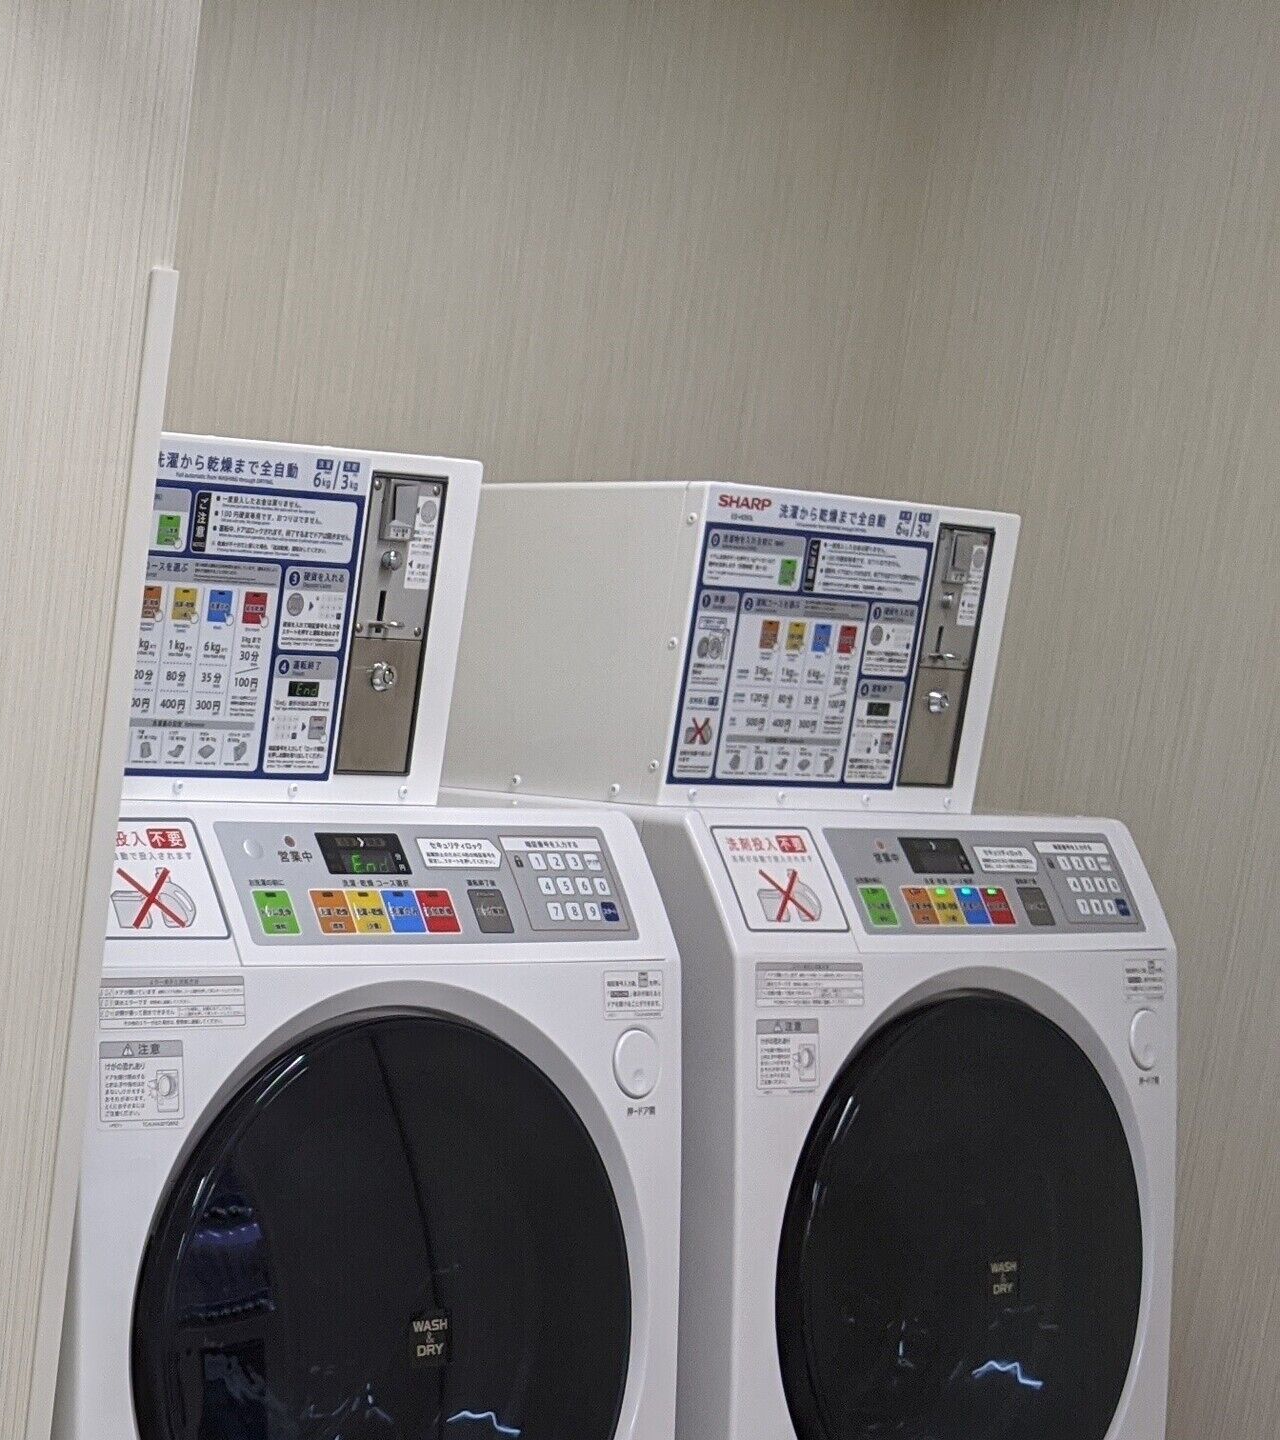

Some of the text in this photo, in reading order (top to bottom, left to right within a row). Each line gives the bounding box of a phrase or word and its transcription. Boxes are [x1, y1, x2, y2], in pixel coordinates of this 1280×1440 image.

[718, 494, 772, 511] SHARP
[150, 830, 184, 847] 不要
[278, 850, 313, 863] 営業中
[138, 1042, 161, 1056] 注意
[412, 1318, 449, 1333] WASH
[416, 1343, 445, 1358] DRY
